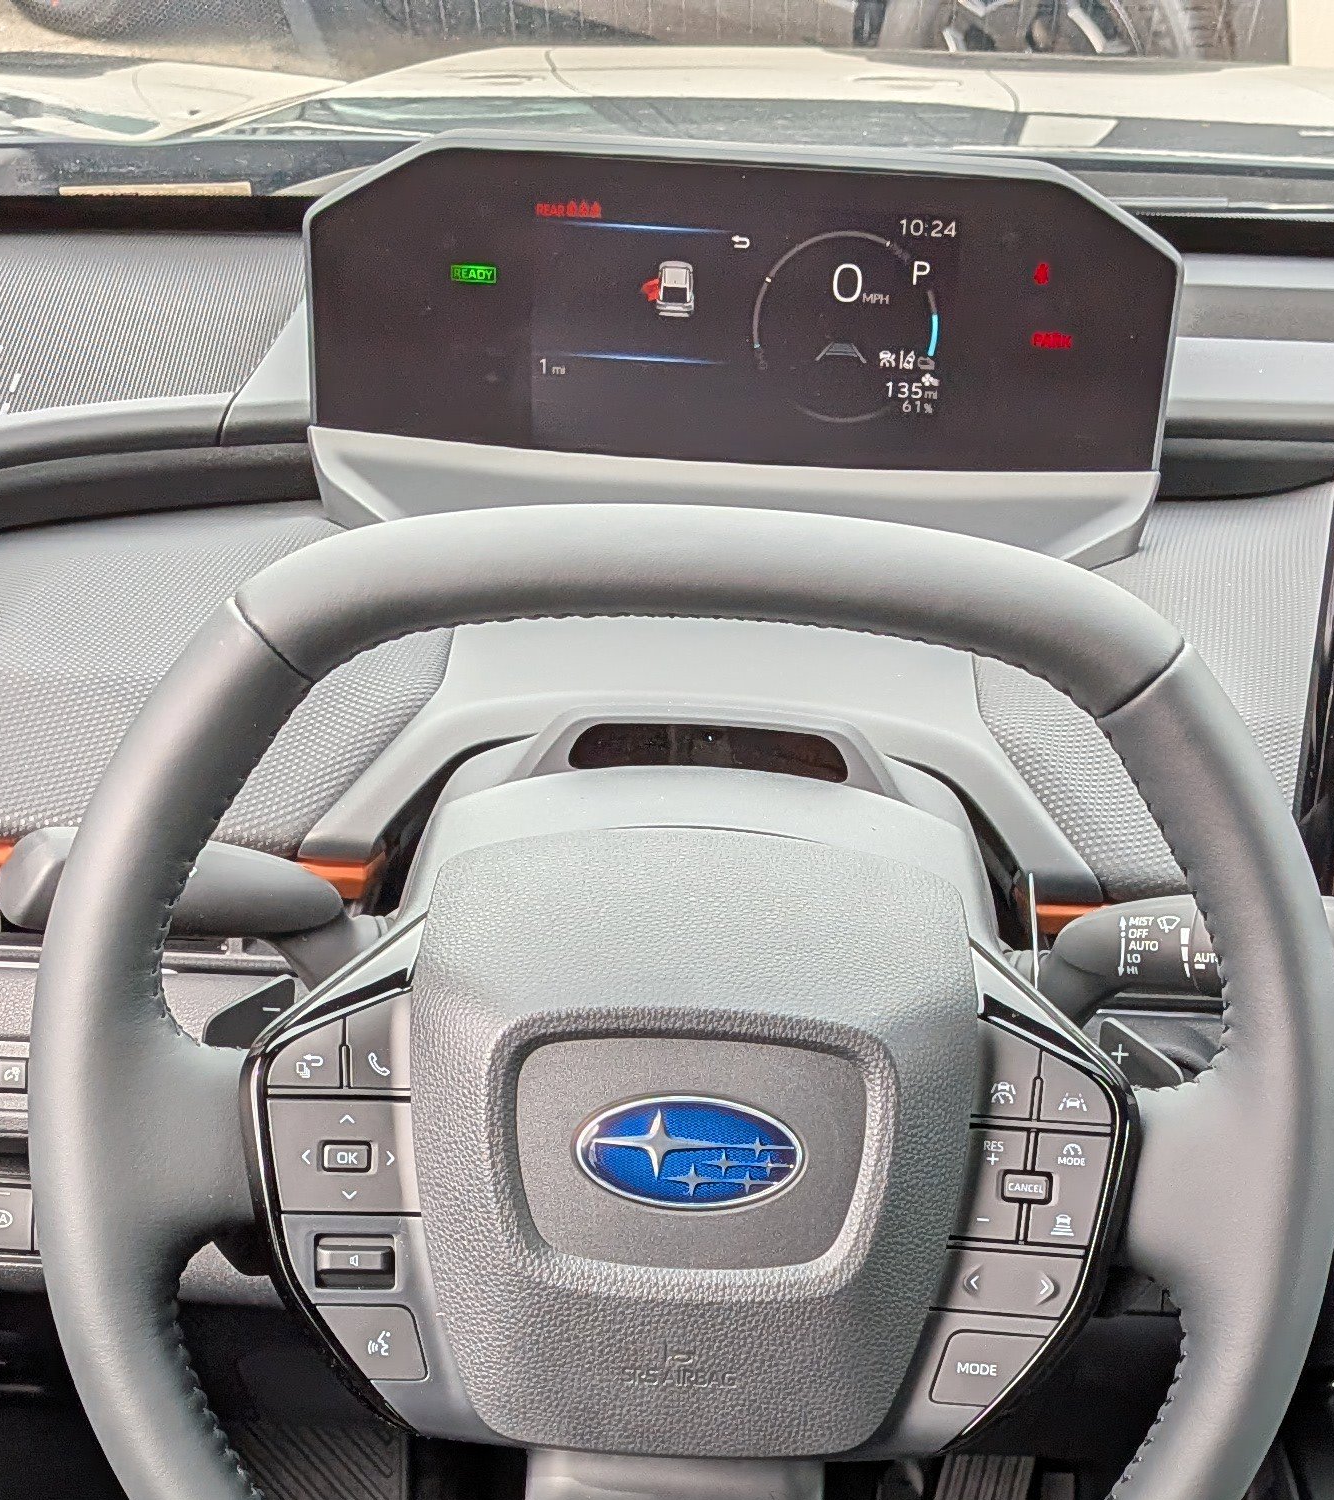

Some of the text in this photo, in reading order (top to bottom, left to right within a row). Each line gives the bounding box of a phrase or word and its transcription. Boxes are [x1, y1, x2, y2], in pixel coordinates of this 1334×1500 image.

[899, 219, 957, 238] 10:24
[453, 266, 493, 280] READY
[912, 261, 931, 286] P
[832, 263, 890, 305] 0 MPH
[539, 358, 566, 375] 1 mi
[885, 381, 922, 399] 135
[902, 401, 933, 414] 61%
[1128, 916, 1155, 926] MIST
[1128, 928, 1149, 939] OFF
[1128, 940, 1159, 951] AUTO
[1127, 953, 1141, 964] LO
[1193, 952, 1218, 963] AUT
[1127, 965, 1139, 975] HI
[983, 1140, 1004, 1152] RES
[336, 1151, 358, 1165] OK
[1057, 1156, 1086, 1166] MODE
[1008, 1182, 1044, 1194] CANCEL
[956, 1361, 998, 1377] MODE
